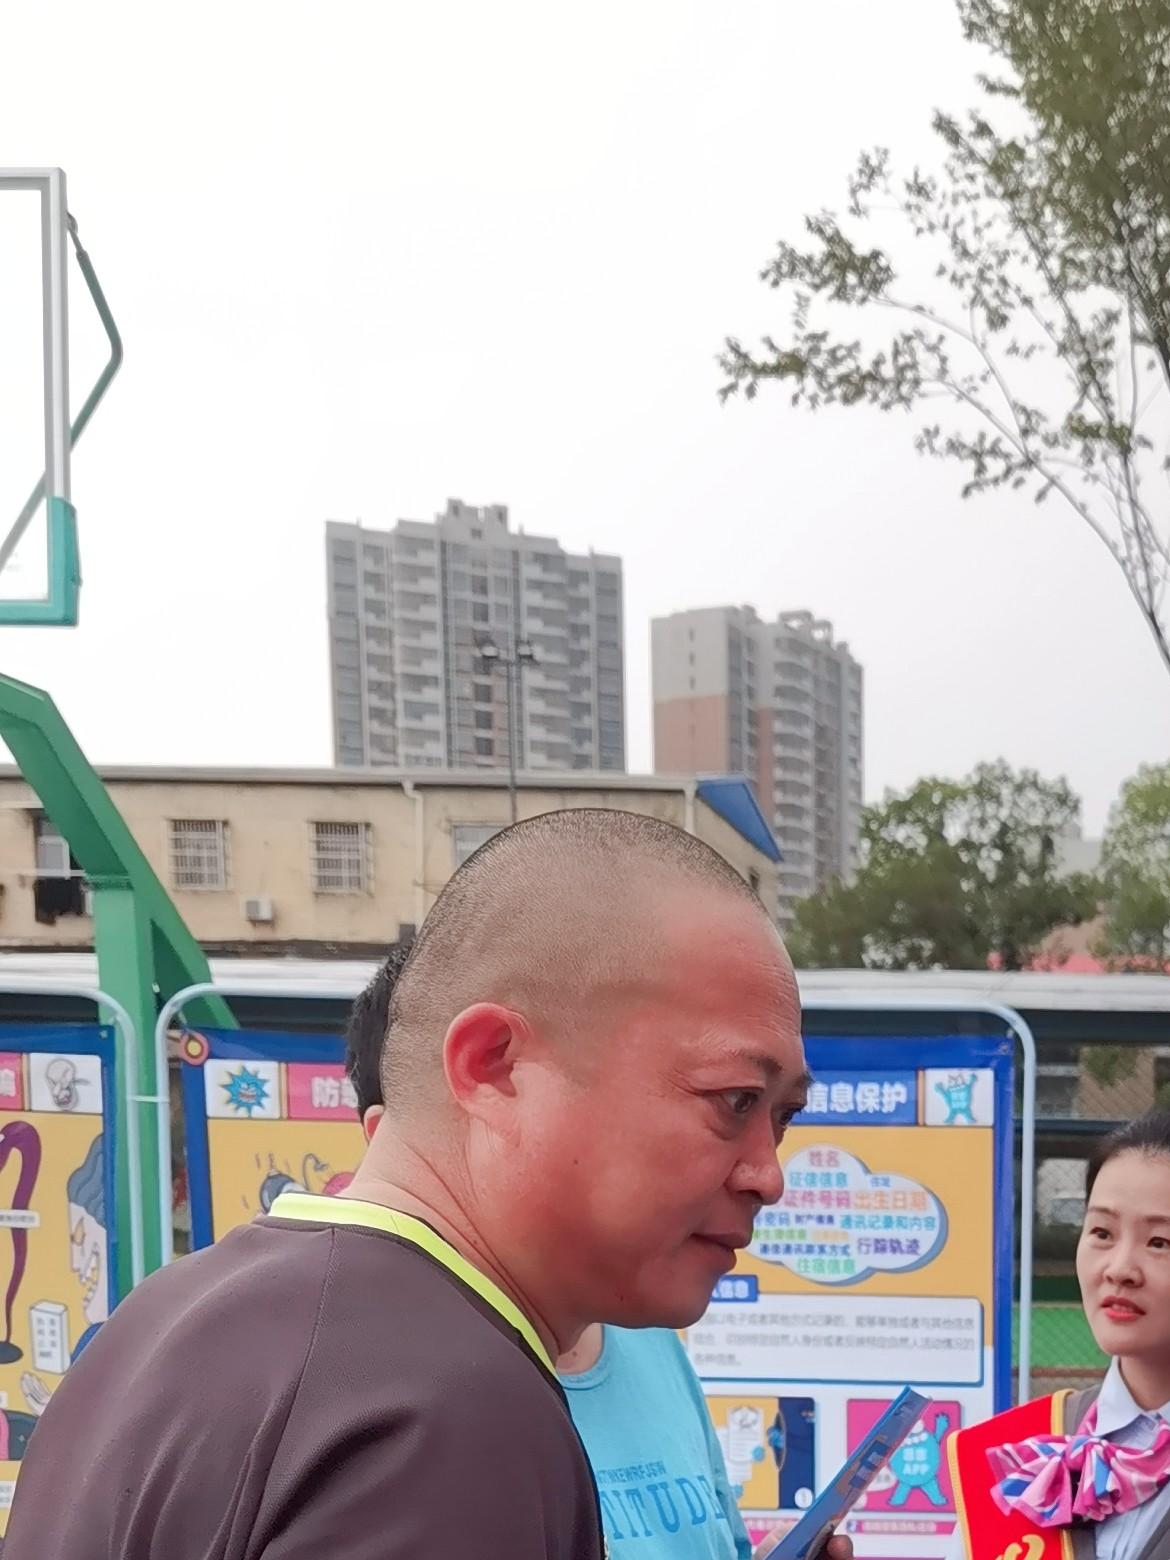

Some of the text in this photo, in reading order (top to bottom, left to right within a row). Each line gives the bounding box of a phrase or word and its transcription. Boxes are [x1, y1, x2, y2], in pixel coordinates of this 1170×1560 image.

[809, 1150, 840, 1168] 姓名
[854, 1191, 928, 1211] 出生日期
[857, 1237, 921, 1257] 行踪轨迹
